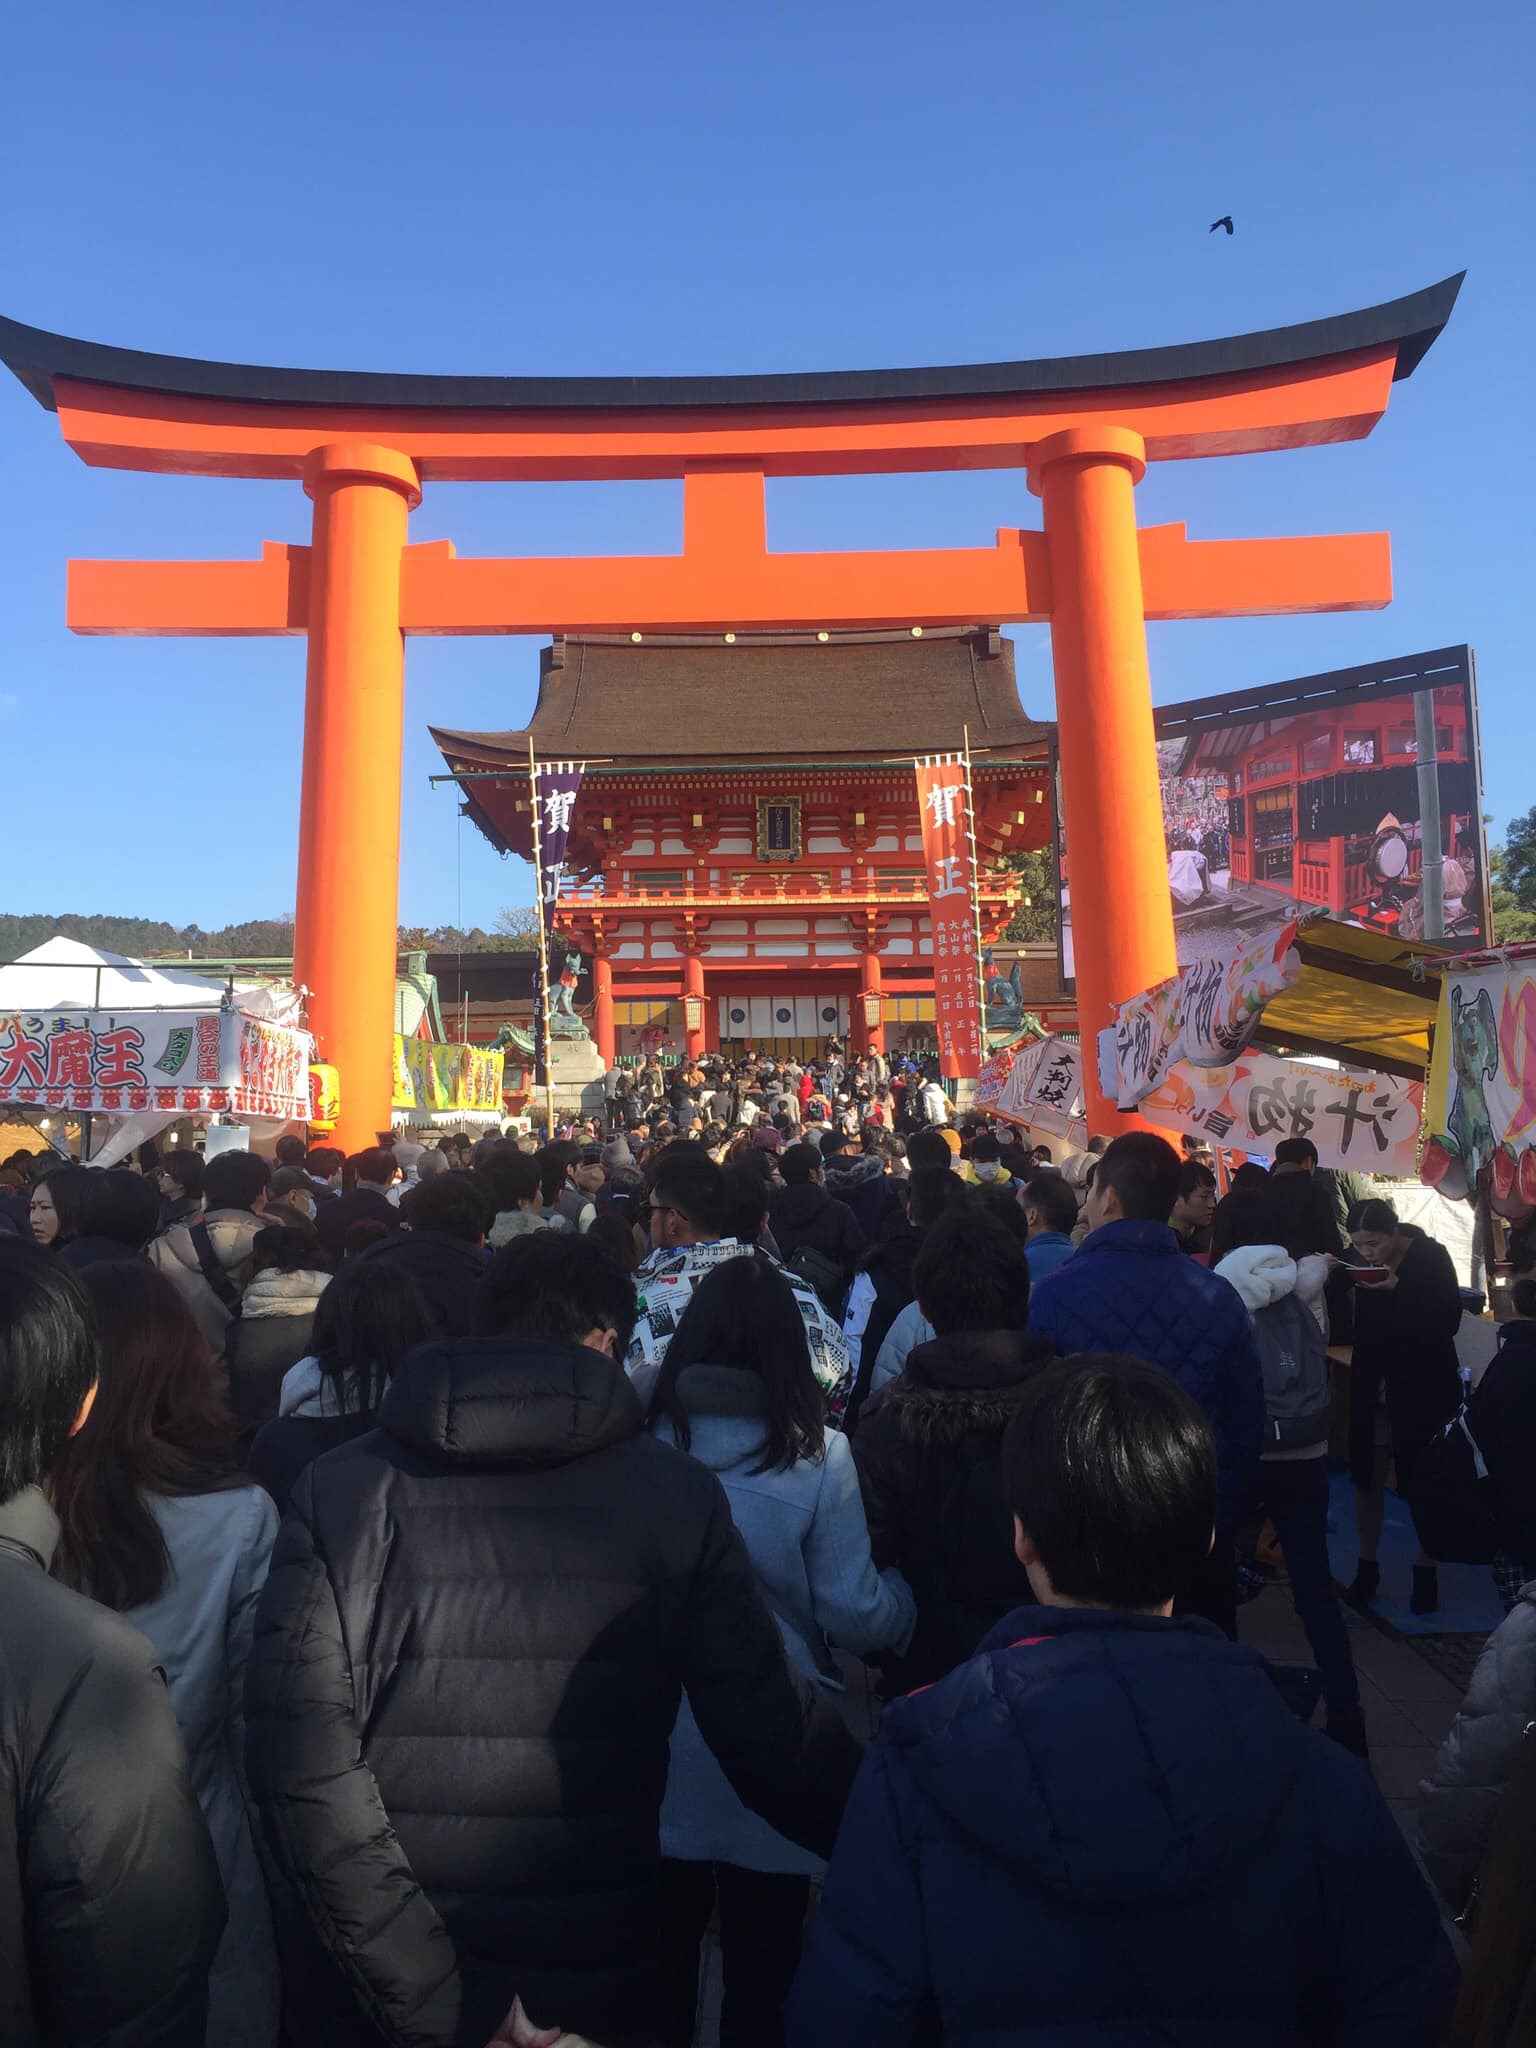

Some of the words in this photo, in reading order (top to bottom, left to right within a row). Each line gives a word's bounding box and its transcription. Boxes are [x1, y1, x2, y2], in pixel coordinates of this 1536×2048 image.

[926, 783, 967, 899] 賀正
[0, 1027, 146, 1088] 大魔王
